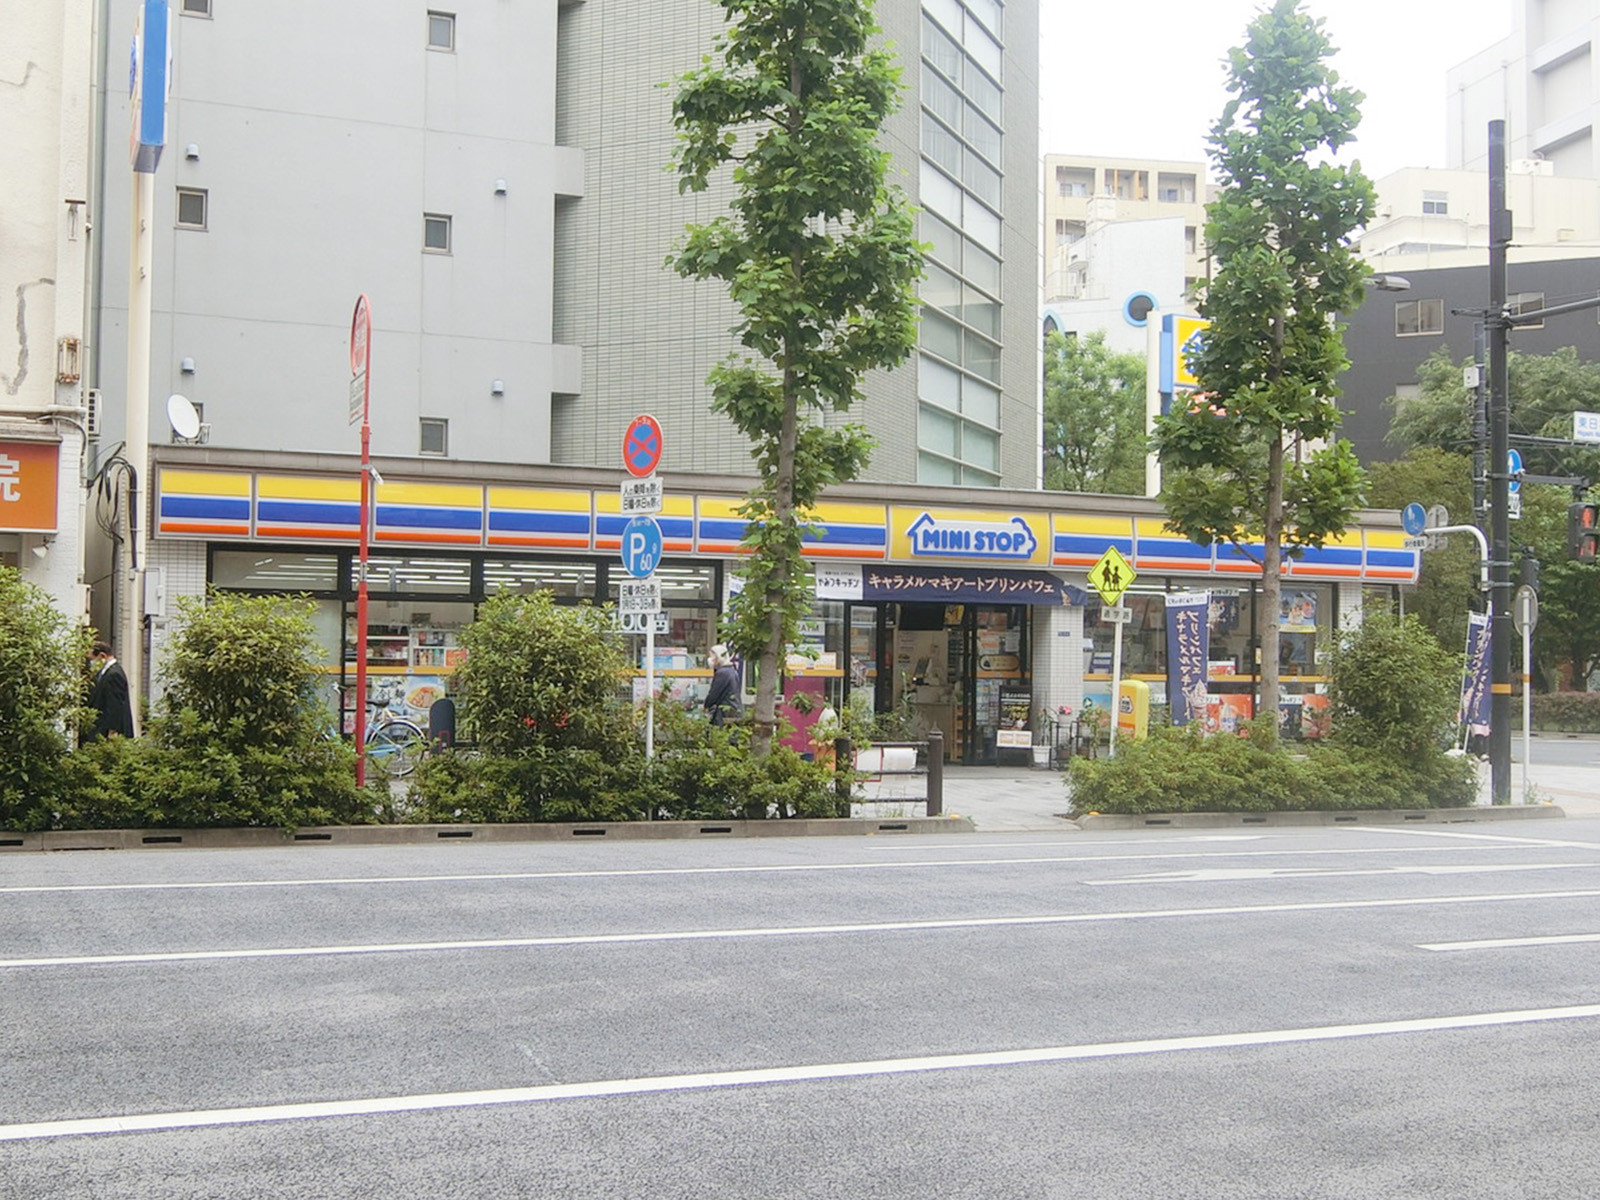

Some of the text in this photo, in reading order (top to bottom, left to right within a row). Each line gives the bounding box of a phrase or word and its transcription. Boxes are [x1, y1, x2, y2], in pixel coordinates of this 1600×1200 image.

[630, 532, 646, 571] P
[923, 528, 1027, 552] MINI STOP
[868, 573, 1055, 594] キャラメルマキアートプリンパフェ
